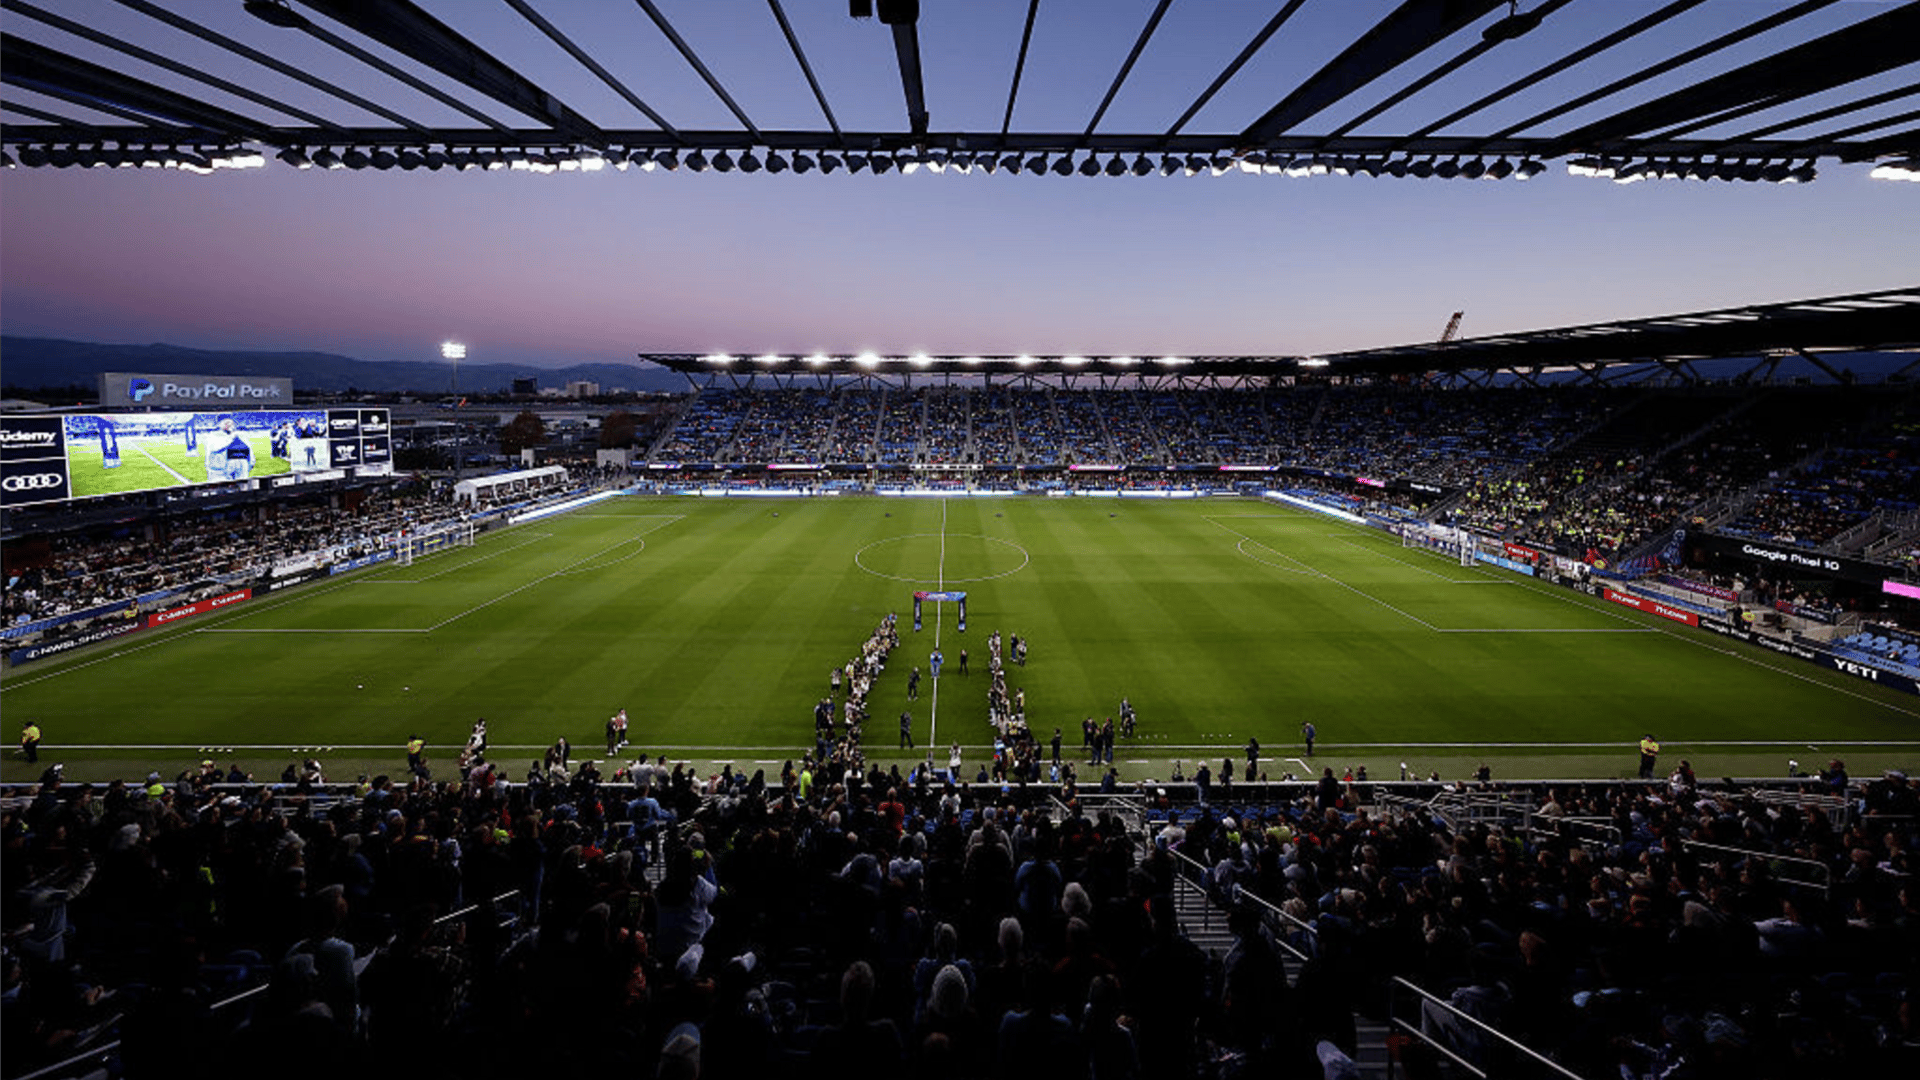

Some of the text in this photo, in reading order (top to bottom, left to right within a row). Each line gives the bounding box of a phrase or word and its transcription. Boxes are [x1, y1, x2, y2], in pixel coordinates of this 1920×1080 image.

[162, 383, 281, 399] PayPal Park
[1742, 544, 1840, 571] Google Pixel 10
[1834, 658, 1878, 680] YETI
